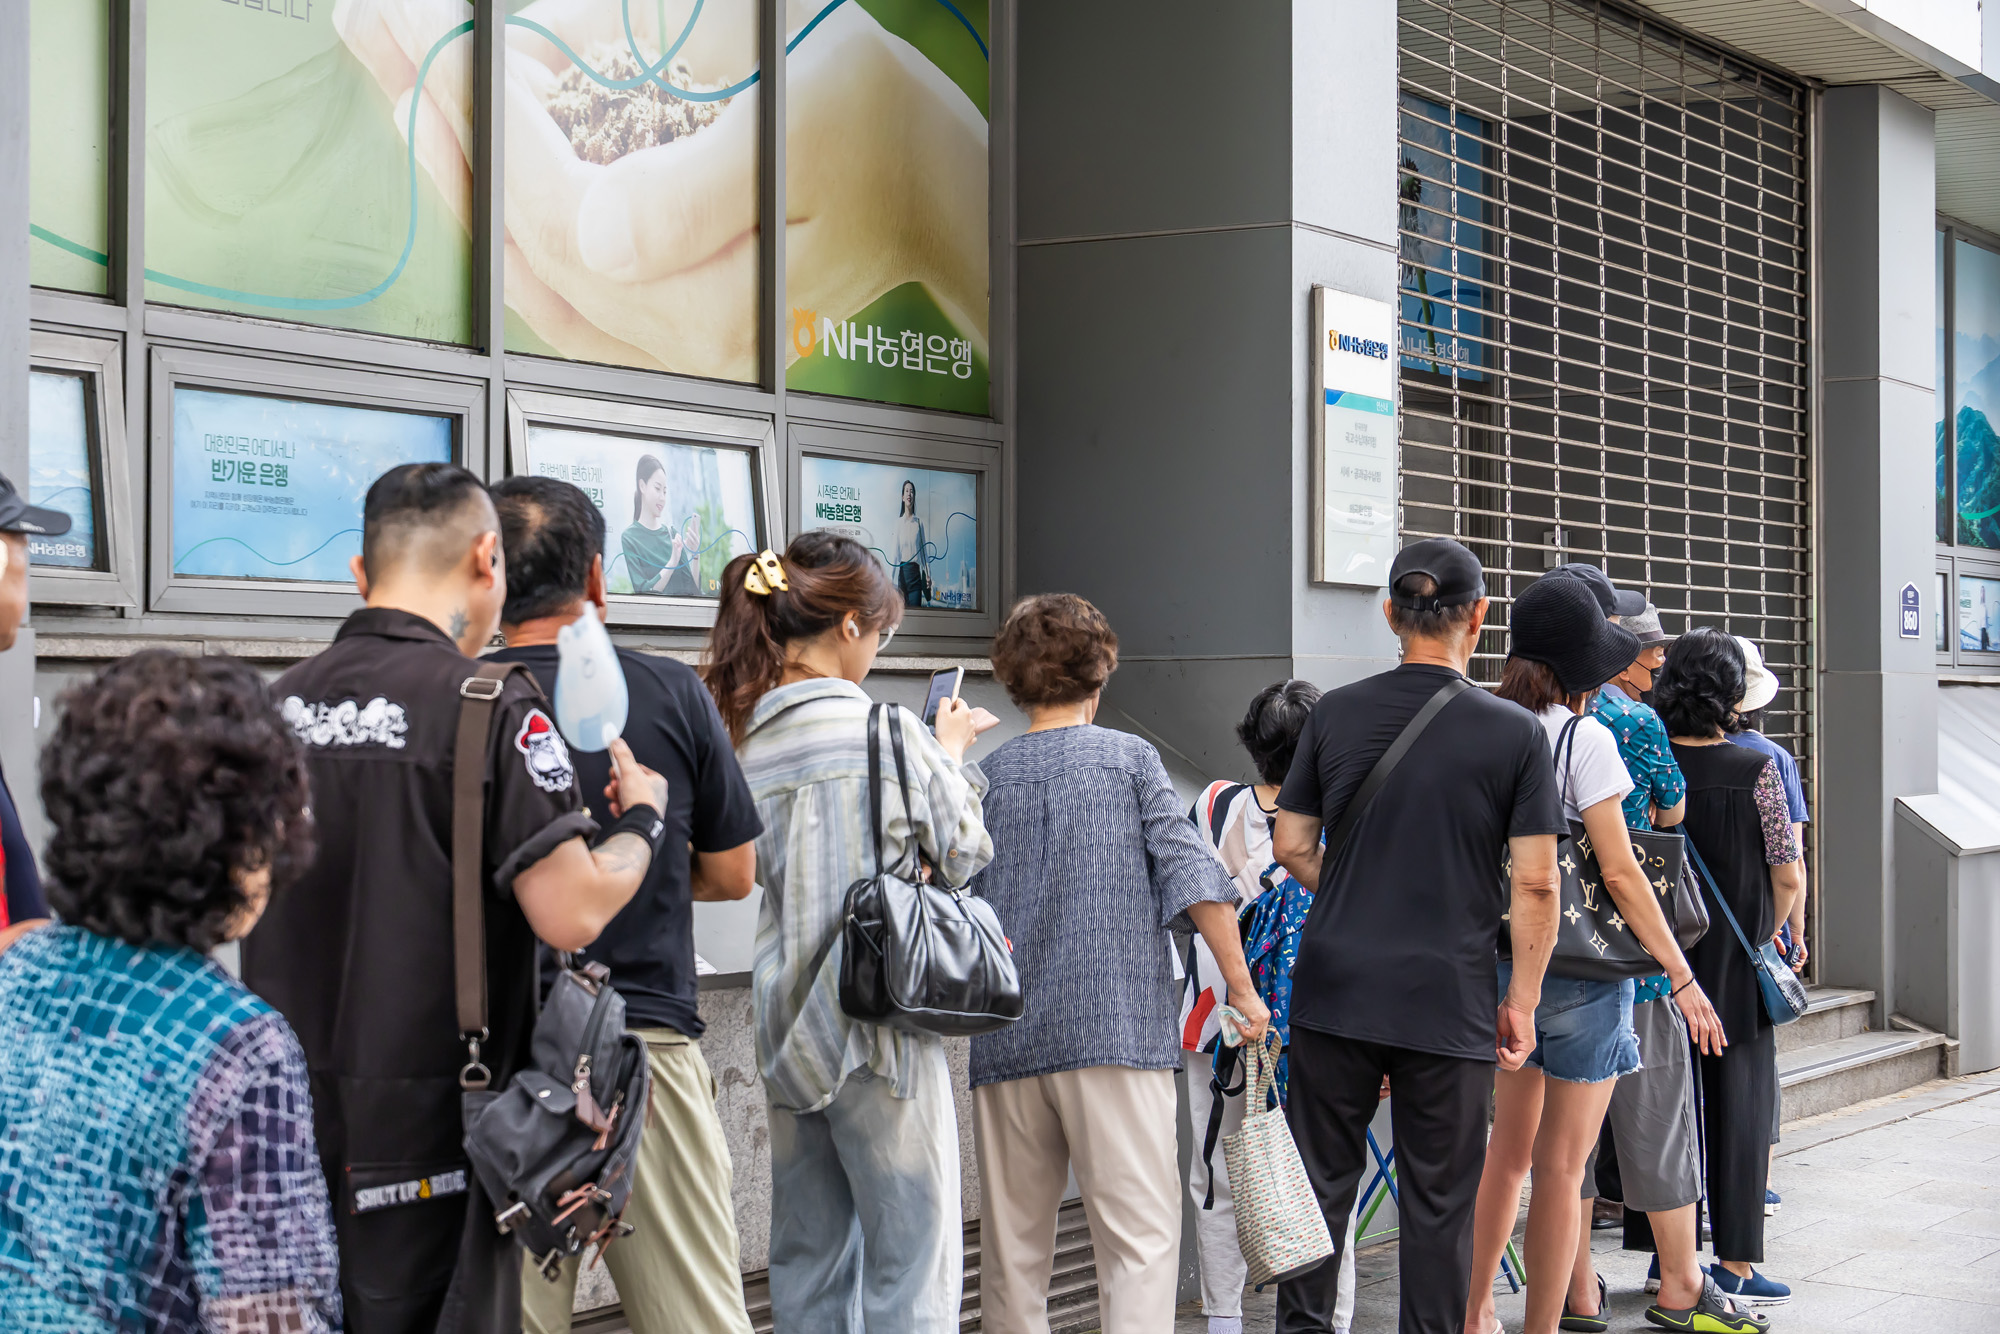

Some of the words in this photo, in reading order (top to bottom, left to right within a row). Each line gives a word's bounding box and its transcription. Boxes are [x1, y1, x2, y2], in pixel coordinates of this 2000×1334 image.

[823, 317, 972, 379] NH농협은행
[1338, 333, 1389, 360] NH농협은행
[204, 433, 250, 455] 대한민국
[251, 438, 296, 459] 어디서나
[211, 458, 257, 485] 반가운
[259, 462, 289, 488] 은행
[817, 484, 839, 500] 시작은
[839, 486, 861, 501] 언제나
[815, 502, 862, 523] NH농협은행
[1904, 610, 1918, 631] 860
